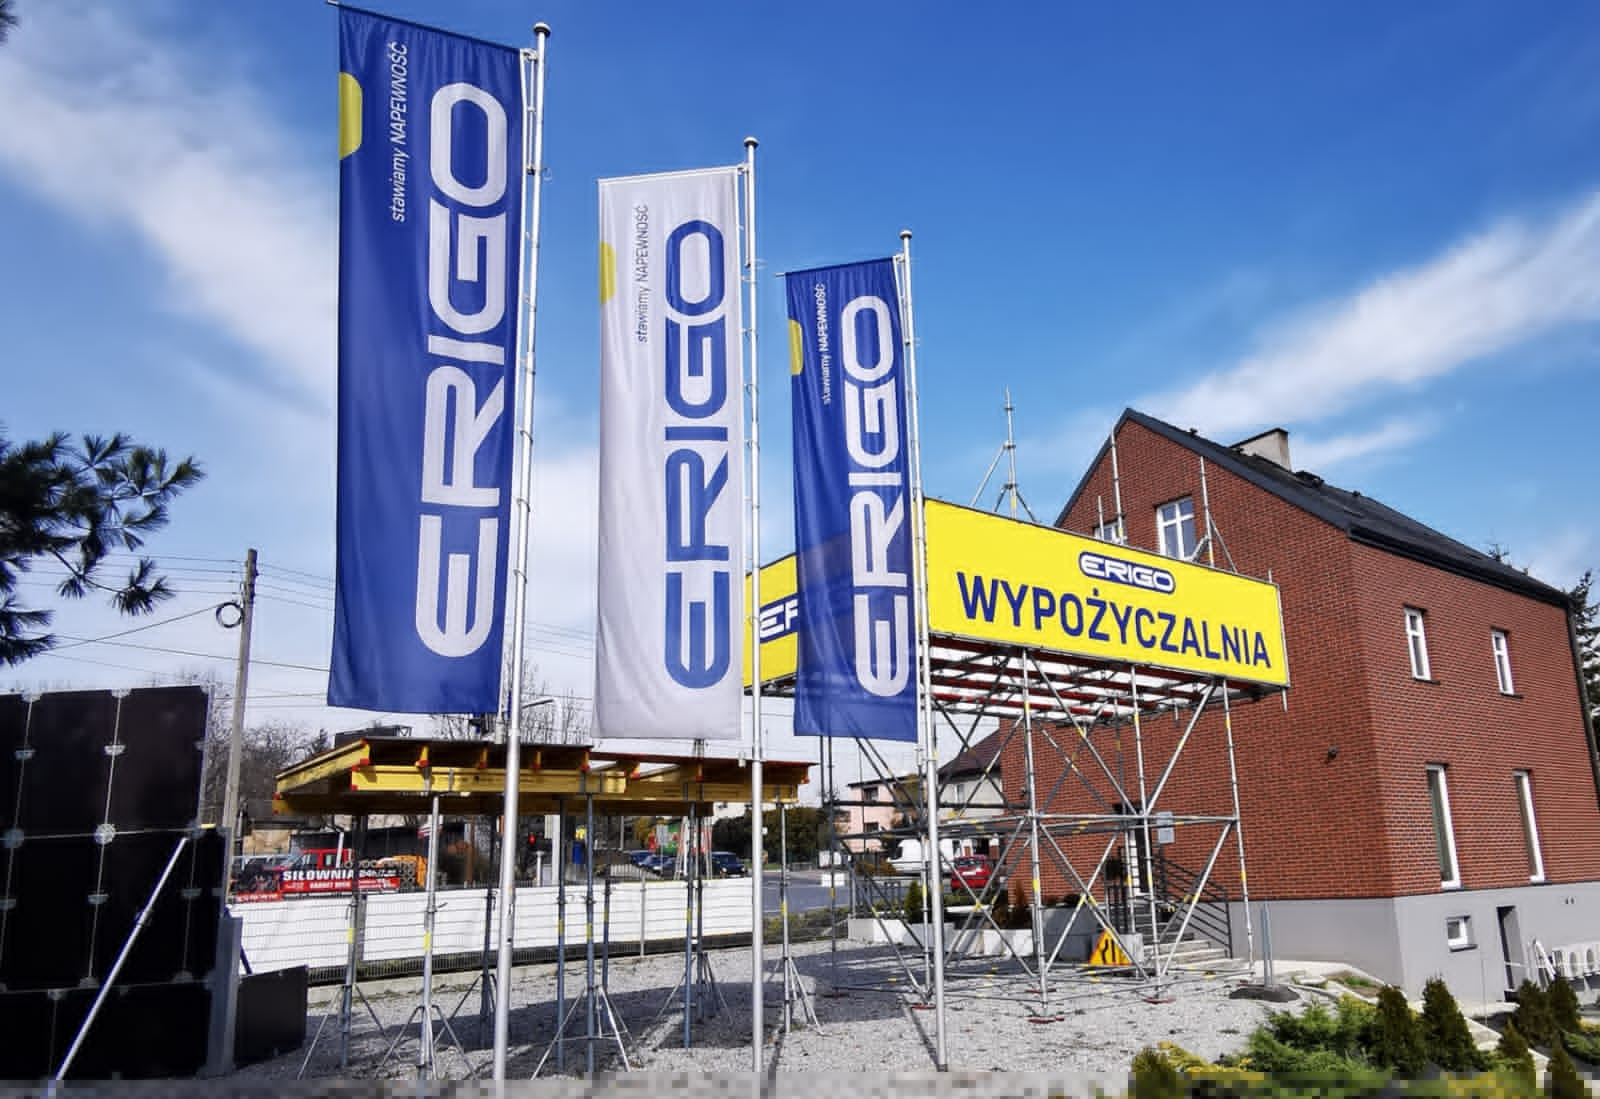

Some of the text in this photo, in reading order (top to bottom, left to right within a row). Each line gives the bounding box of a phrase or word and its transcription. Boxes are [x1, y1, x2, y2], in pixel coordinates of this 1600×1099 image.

[387, 41, 410, 222] stawiamy NAPEWNOŚĆ
[634, 204, 651, 343] stawiamy NAPEWNOŚĆ
[415, 82, 507, 658] ERIGO
[665, 219, 730, 689] ERIGO
[841, 295, 910, 697] ERIGO
[956, 571, 1269, 669] WYPOŻYCZALNIA
[1080, 553, 1175, 592] ERIGO
[282, 869, 354, 881] SIŁOWNIA
